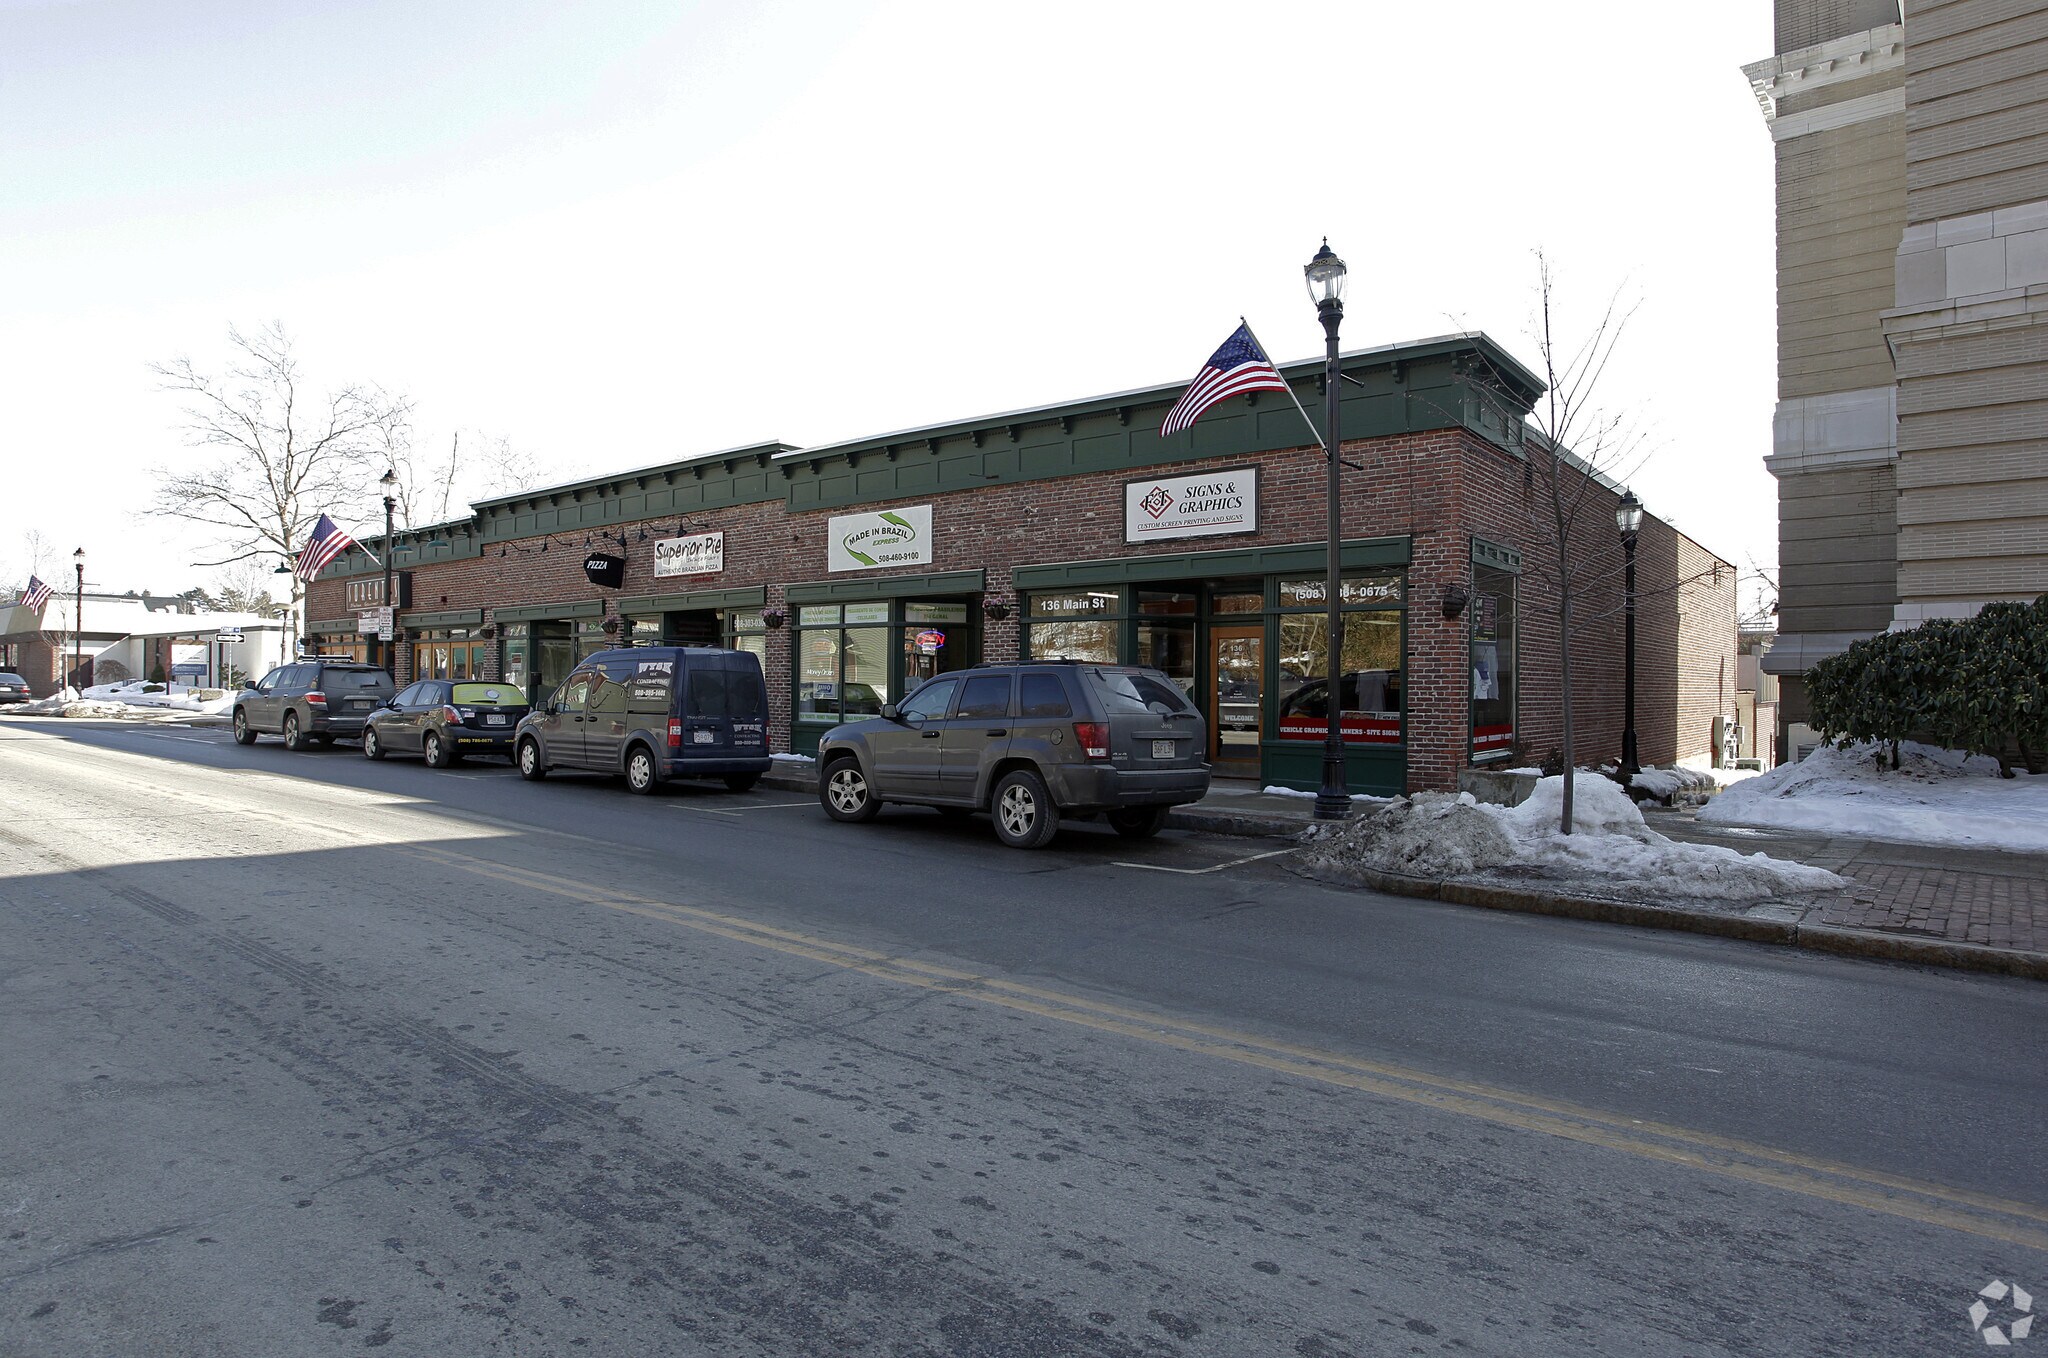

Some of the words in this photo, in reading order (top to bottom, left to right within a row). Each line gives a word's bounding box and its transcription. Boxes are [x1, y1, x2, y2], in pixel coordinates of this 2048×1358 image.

[1184, 482, 1223, 499] SIGNS
[1225, 481, 1236, 494] &
[1178, 495, 1243, 514] GRAPHICS
[1137, 522, 1160, 530] CUSTOM
[1161, 520, 1183, 528] SCREEN
[1183, 517, 1211, 526] PRINTING
[1211, 515, 1224, 523] AND
[1224, 513, 1243, 522] SIGNS
[848, 529, 870, 546] MADE
[872, 527, 880, 536] IN
[881, 526, 908, 540] BRAZIL
[872, 537, 899, 546] EXPRESS
[656, 540, 702, 566] Superior
[705, 536, 722, 555] Pie
[878, 551, 919, 563] 508-460-9100
[586, 560, 607, 570] PIZZA
[657, 567, 681, 576] AUTHENTIC
[682, 565, 704, 573] BRAZILIAN
[705, 563, 719, 571] PIZZA
[348, 579, 398, 603] SORENTS
[1041, 600, 1060, 611] 136
[1063, 599, 1089, 610] Main
[1092, 598, 1105, 609] St
[915, 634, 946, 646] OPEN
[806, 668, 822, 677] Money
[1224, 714, 1254, 722] WELCOME
[1280, 726, 1303, 734] VEHICLE
[1303, 726, 1328, 734] GRAPHIC
[1340, 727, 1363, 735] ANNERS
[1382, 729, 1400, 737] SIGNS
